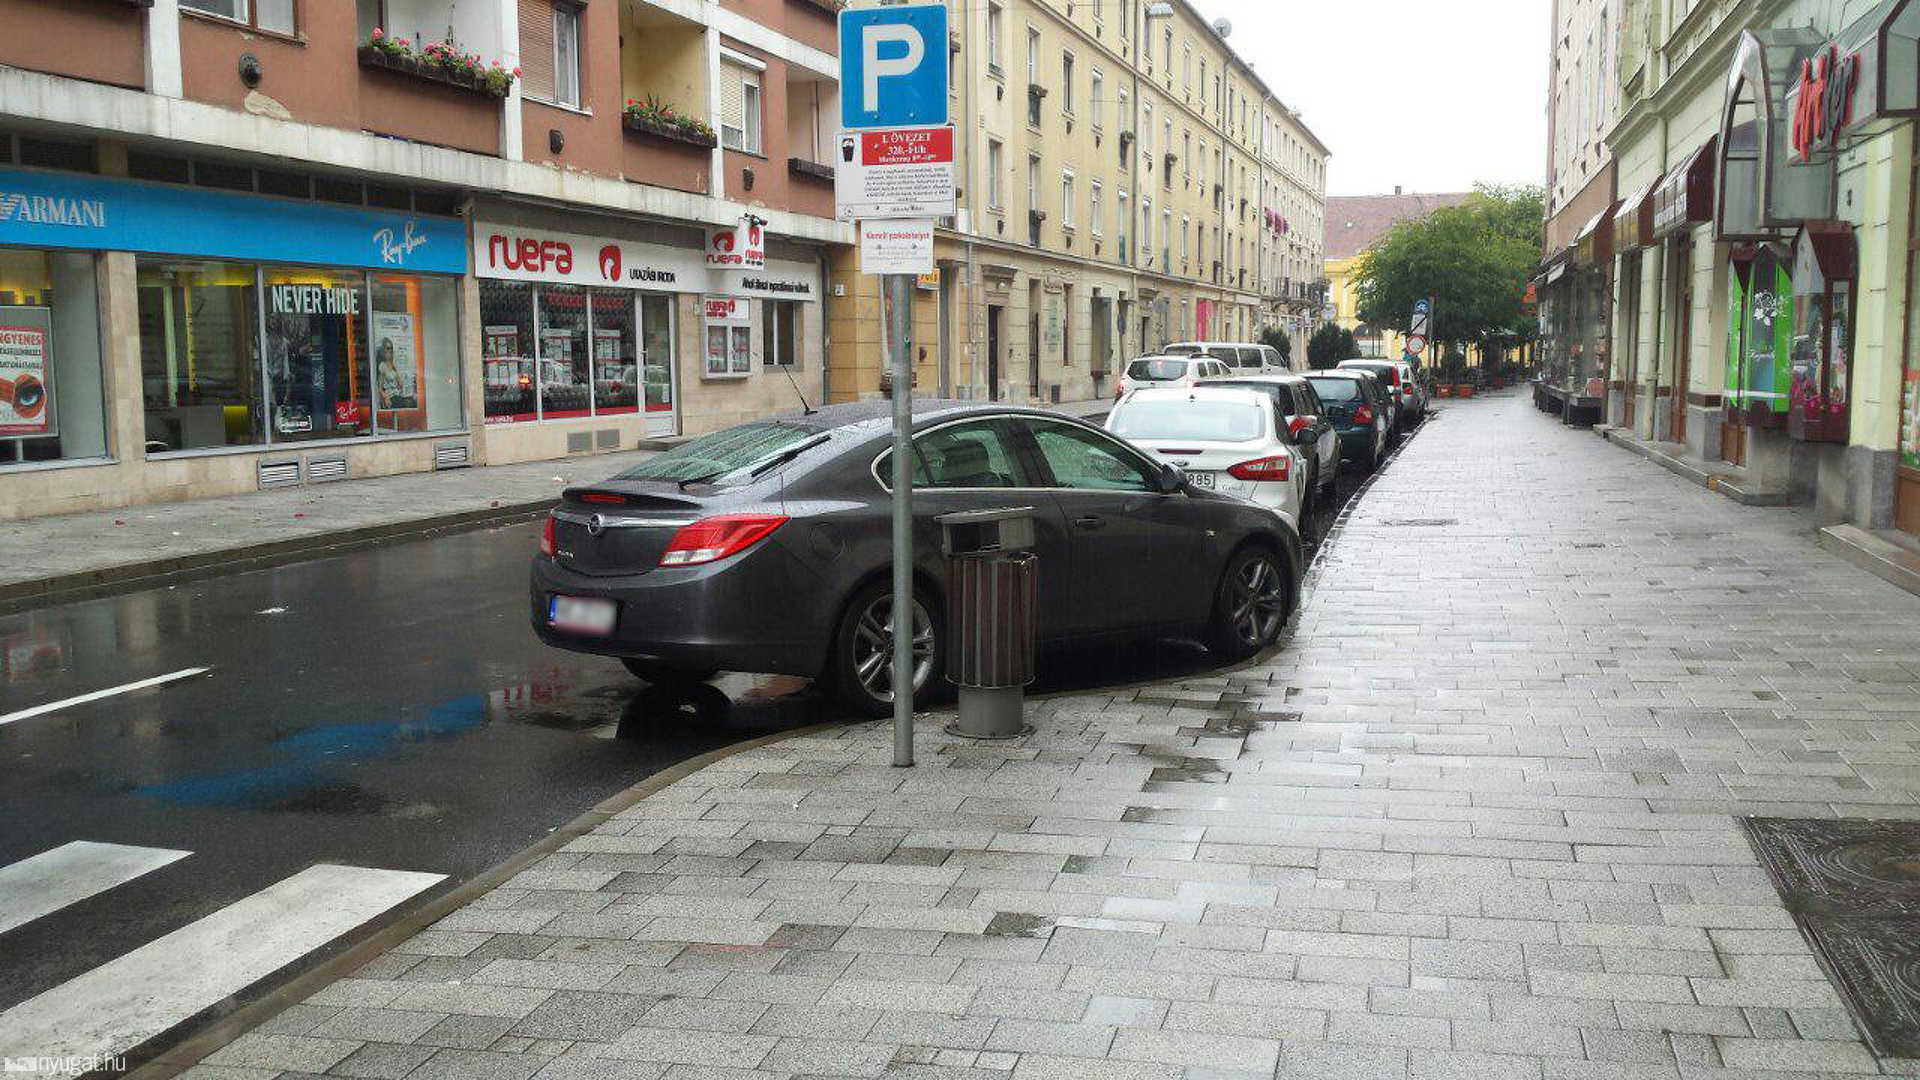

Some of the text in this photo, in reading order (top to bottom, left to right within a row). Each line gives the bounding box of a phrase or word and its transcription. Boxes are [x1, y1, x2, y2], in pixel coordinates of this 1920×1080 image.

[862, 24, 924, 112] P
[16, 194, 105, 228] ARMANI
[373, 222, 429, 264] Ray-Ban
[489, 235, 572, 274] ruefa
[706, 253, 743, 265] ruefa
[272, 285, 359, 314] NEVER HIDE
